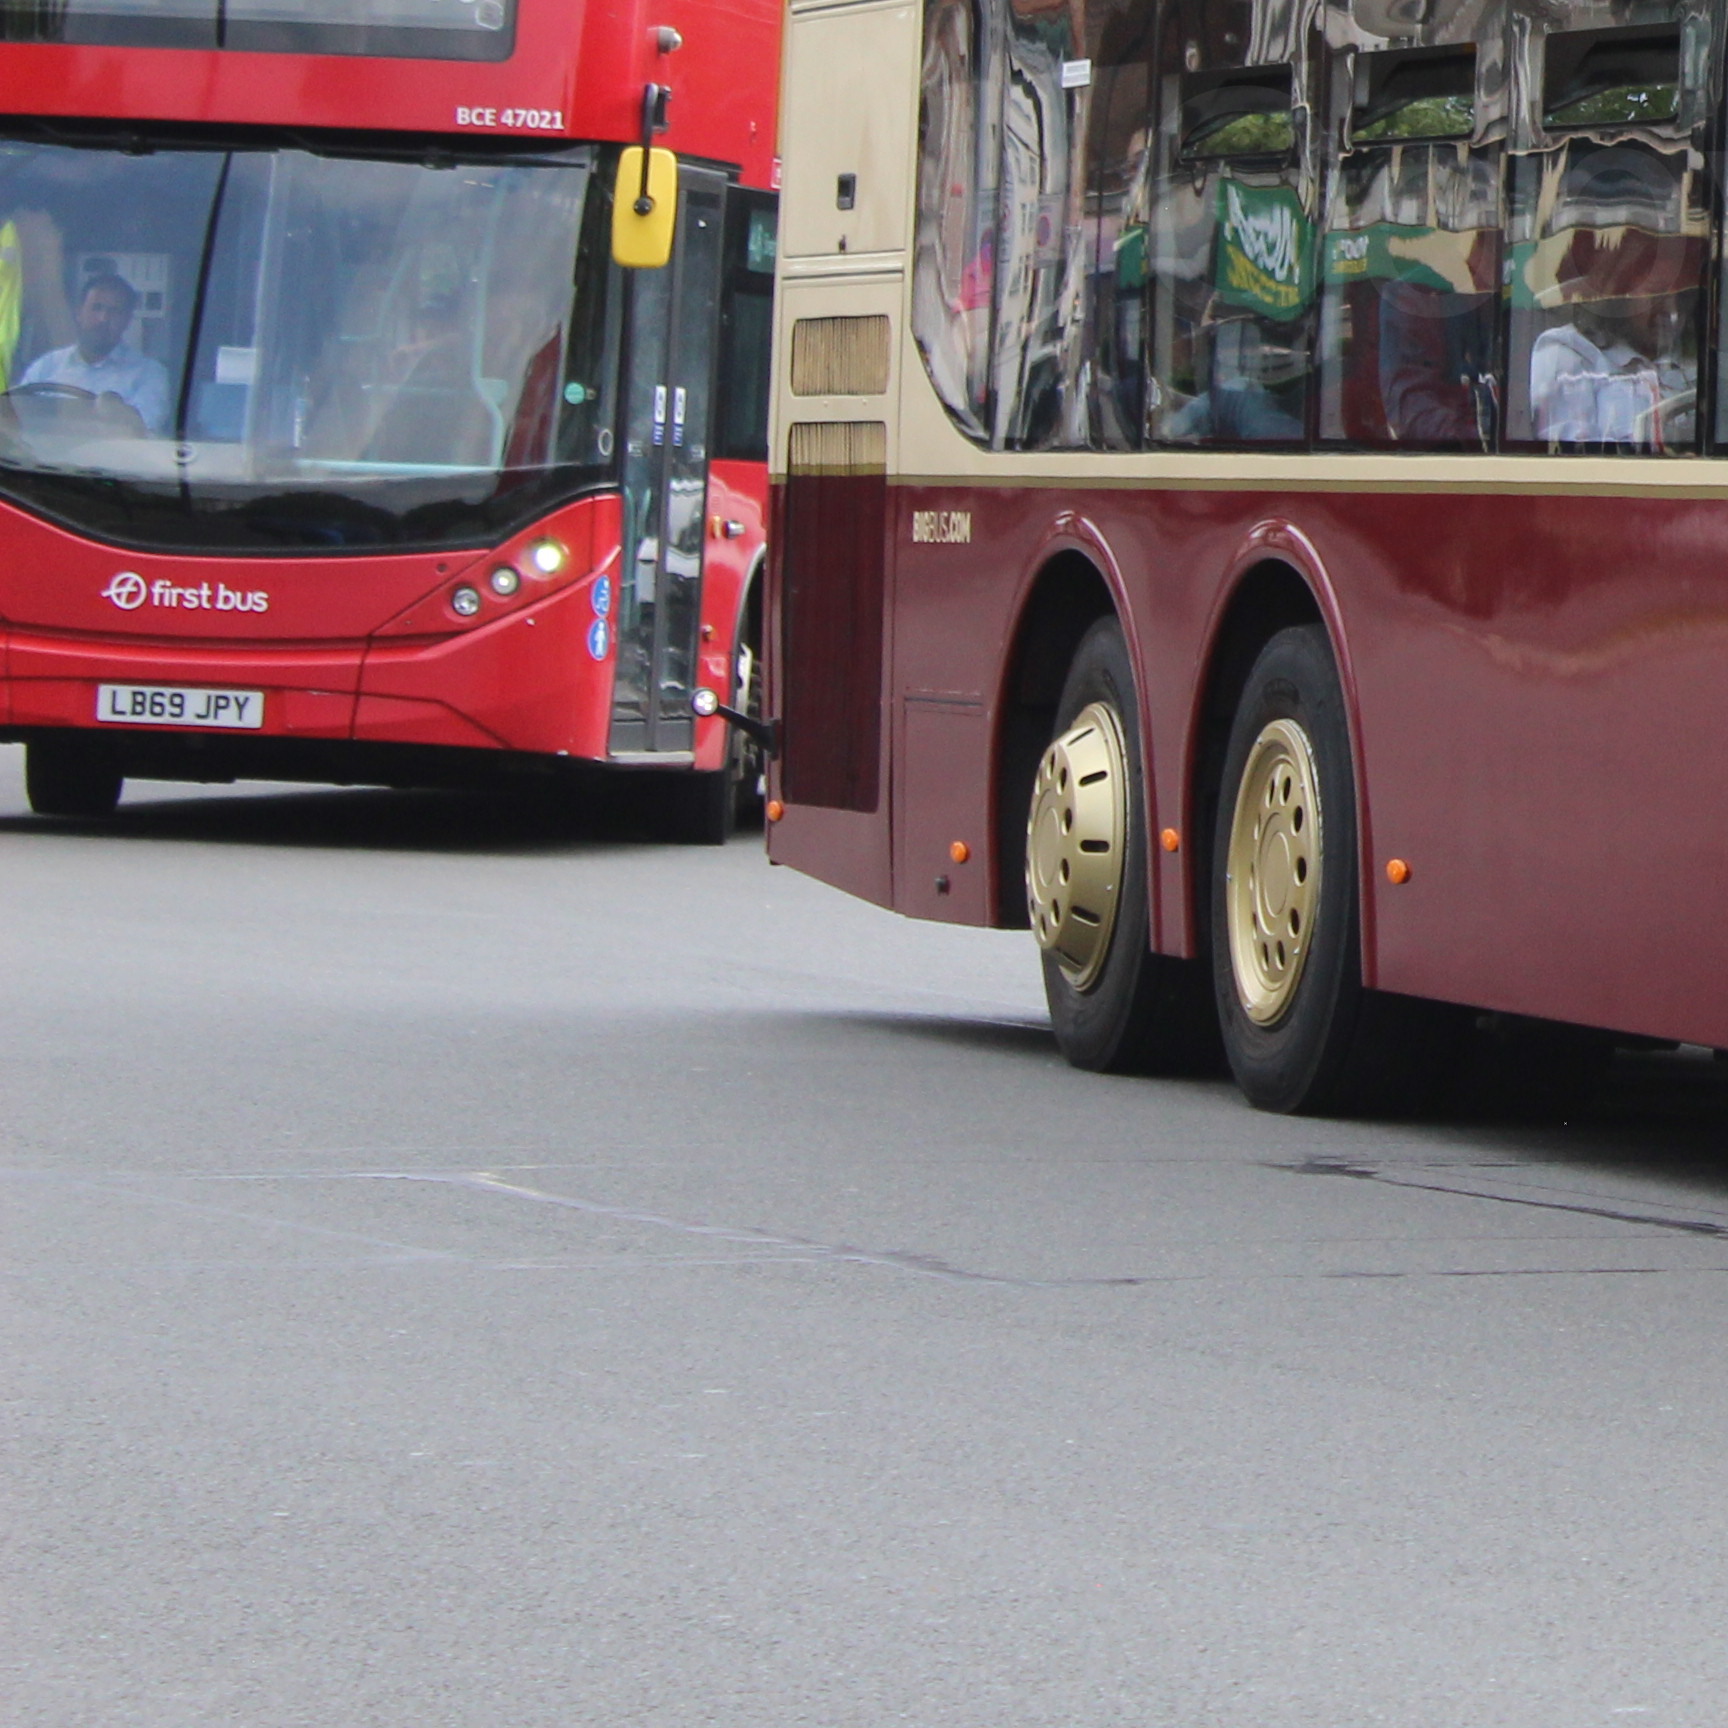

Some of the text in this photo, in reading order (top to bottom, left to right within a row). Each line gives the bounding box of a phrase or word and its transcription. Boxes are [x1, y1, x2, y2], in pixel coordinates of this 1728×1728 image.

[456, 107, 565, 131] BCE 47021
[913, 511, 971, 544] BIGBUS.COM
[152, 580, 269, 613] first bus
[111, 689, 250, 721] LB69 JPY
